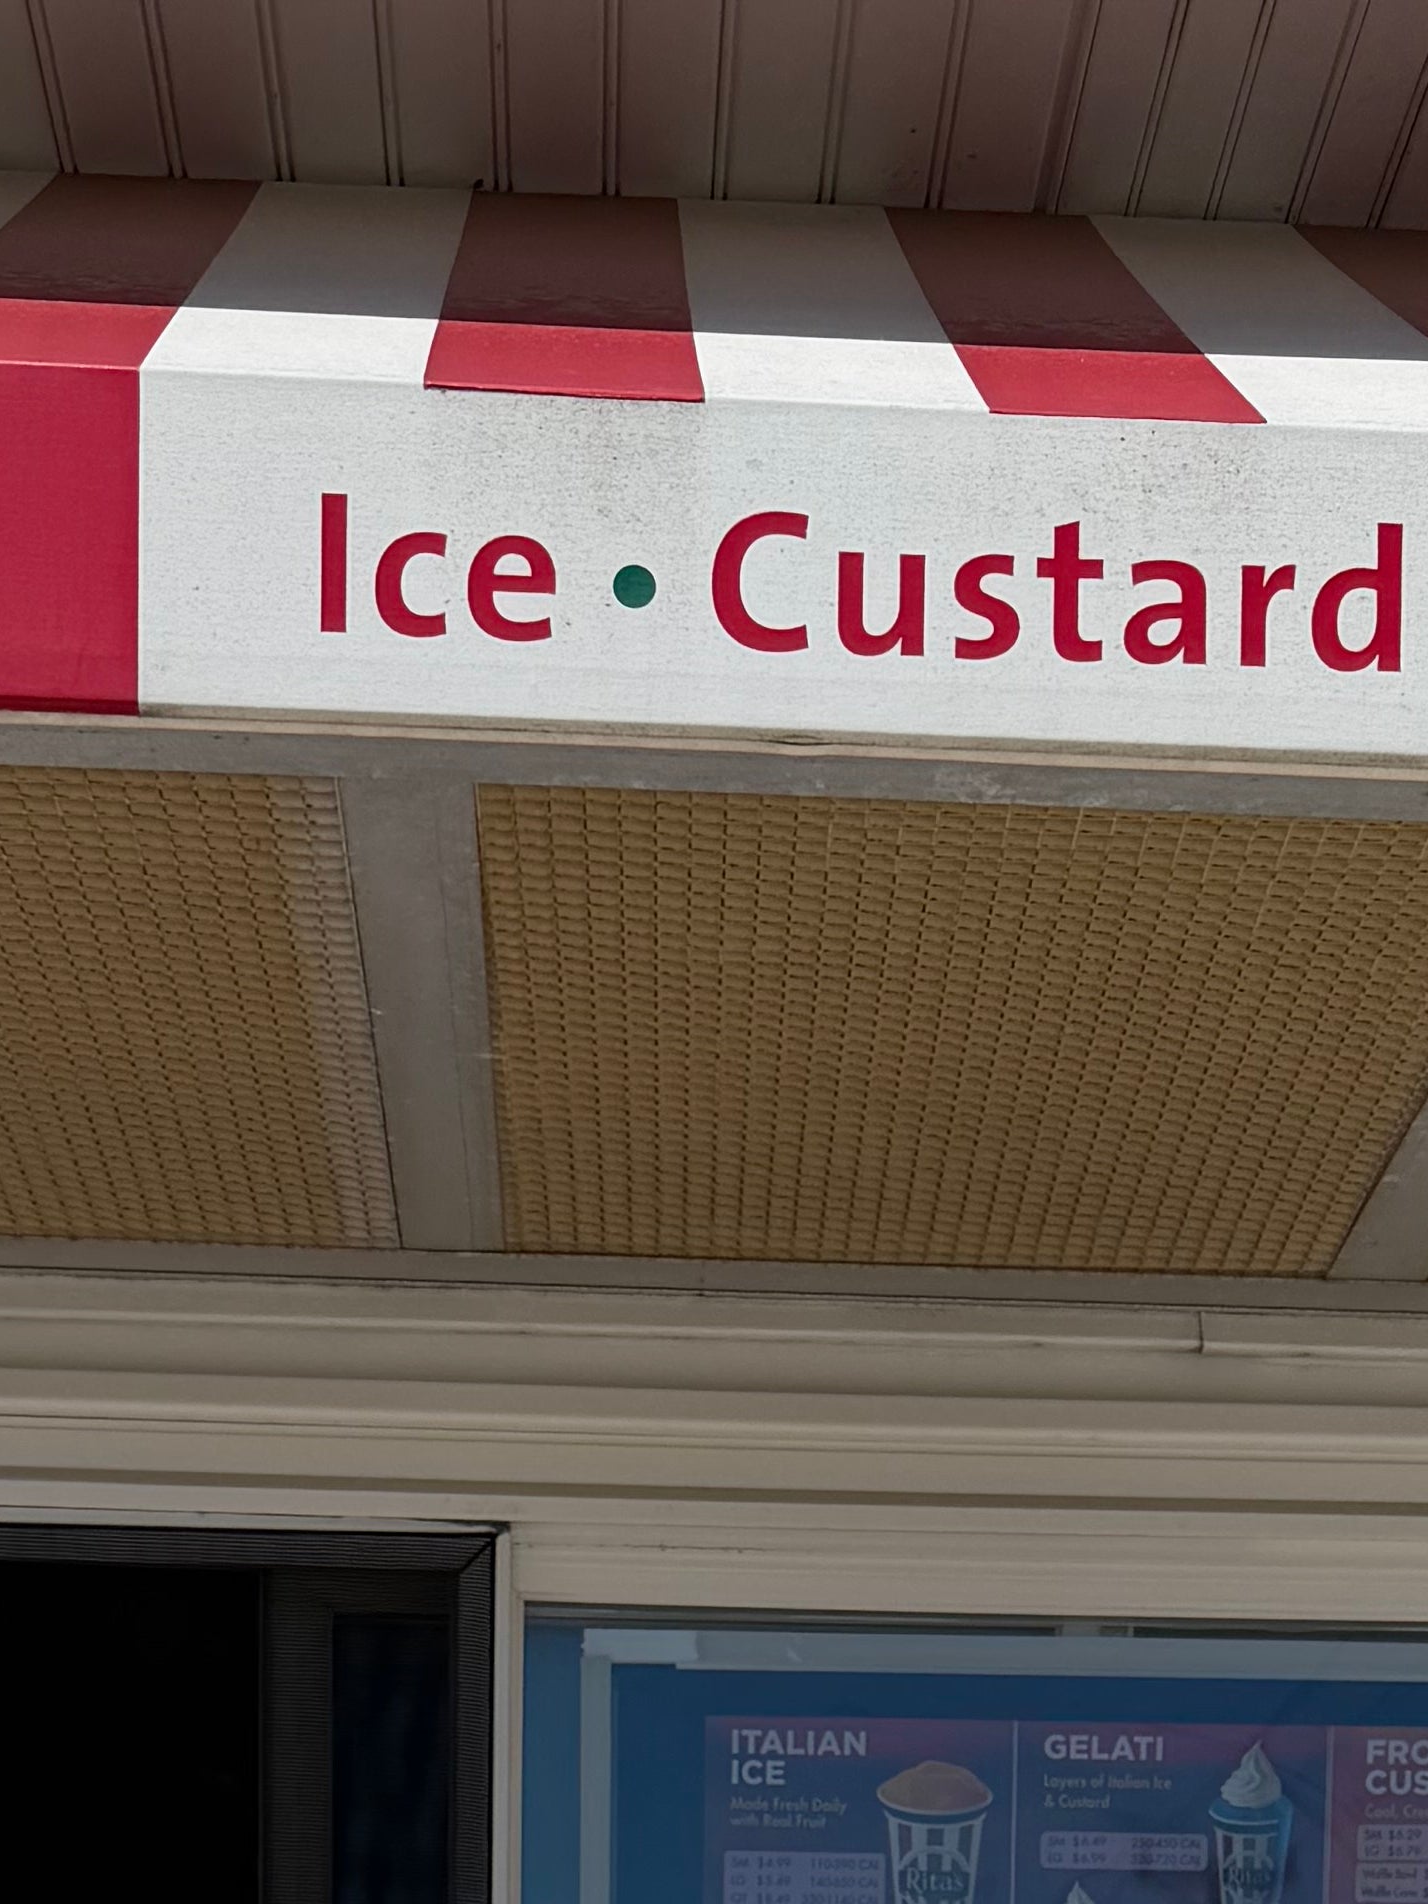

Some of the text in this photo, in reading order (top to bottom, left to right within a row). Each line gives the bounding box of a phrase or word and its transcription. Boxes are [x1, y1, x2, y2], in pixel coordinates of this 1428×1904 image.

[319, 493, 559, 640] Ice
[710, 510, 1402, 674] Custard
[730, 1729, 867, 1756] ITALIAN
[1044, 1735, 1164, 1761] GELATI
[731, 1761, 787, 1786] ICE
